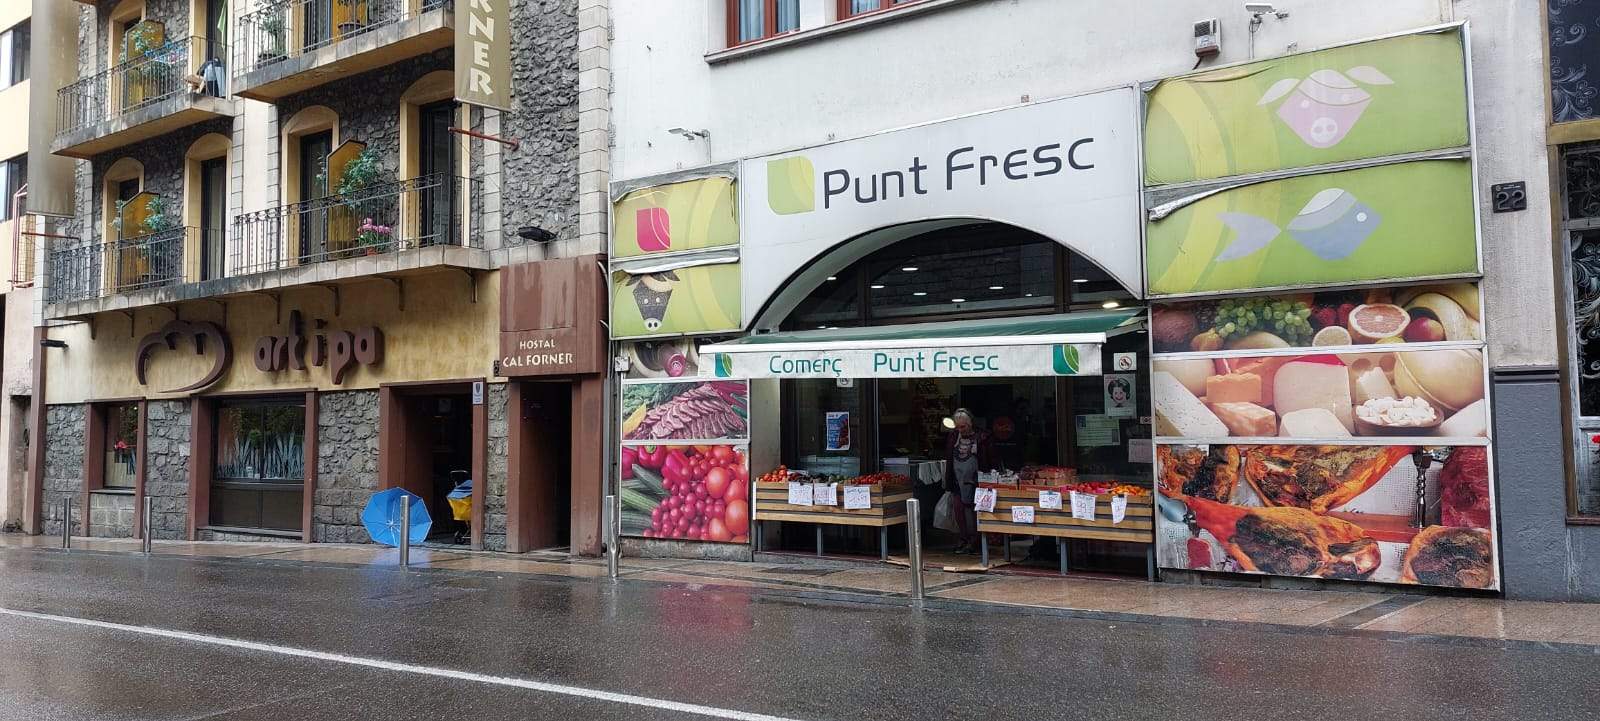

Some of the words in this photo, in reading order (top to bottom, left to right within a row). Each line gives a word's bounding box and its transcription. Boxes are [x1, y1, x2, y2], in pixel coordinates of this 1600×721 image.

[823, 156, 928, 210] Punt
[946, 137, 1095, 191] Fresc
[1496, 189, 1525, 211] 22
[519, 338, 556, 350] HOSTAL
[502, 356, 523, 368] CAL
[526, 352, 573, 366] FORNER
[769, 355, 843, 378] Comerç
[873, 351, 926, 373] Punt
[933, 350, 999, 373] Fresc
